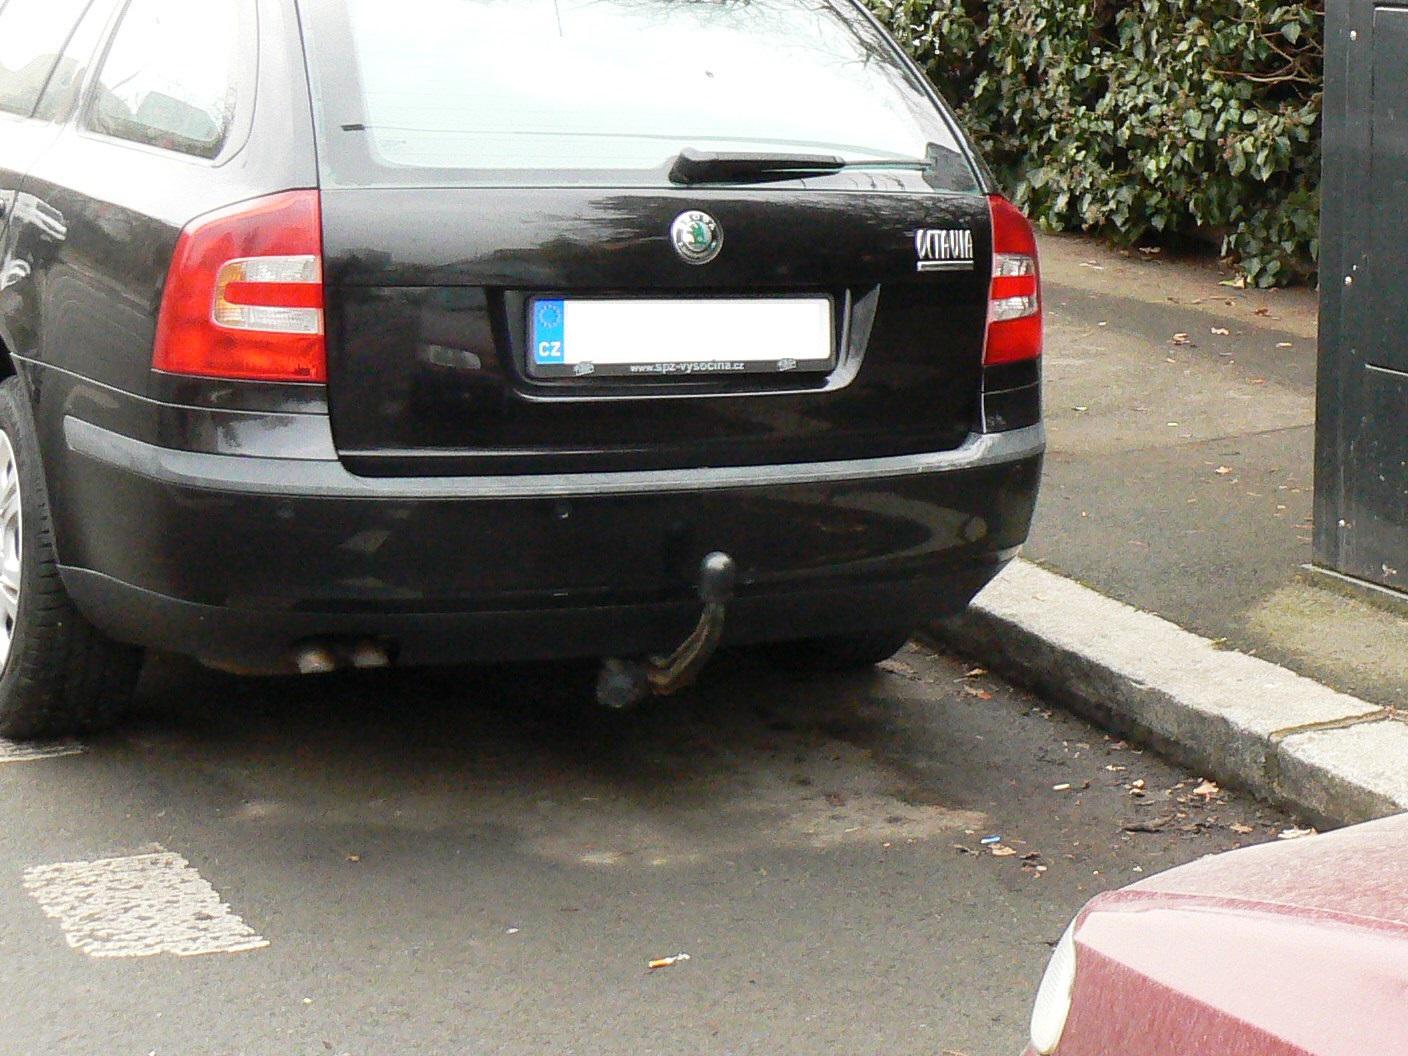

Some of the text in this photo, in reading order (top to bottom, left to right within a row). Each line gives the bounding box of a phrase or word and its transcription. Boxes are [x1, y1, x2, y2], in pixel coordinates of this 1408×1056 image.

[916, 229, 974, 260] OCTAVIA
[539, 341, 561, 357] CZ
[629, 360, 745, 374] www.spz-vysocina.cz
